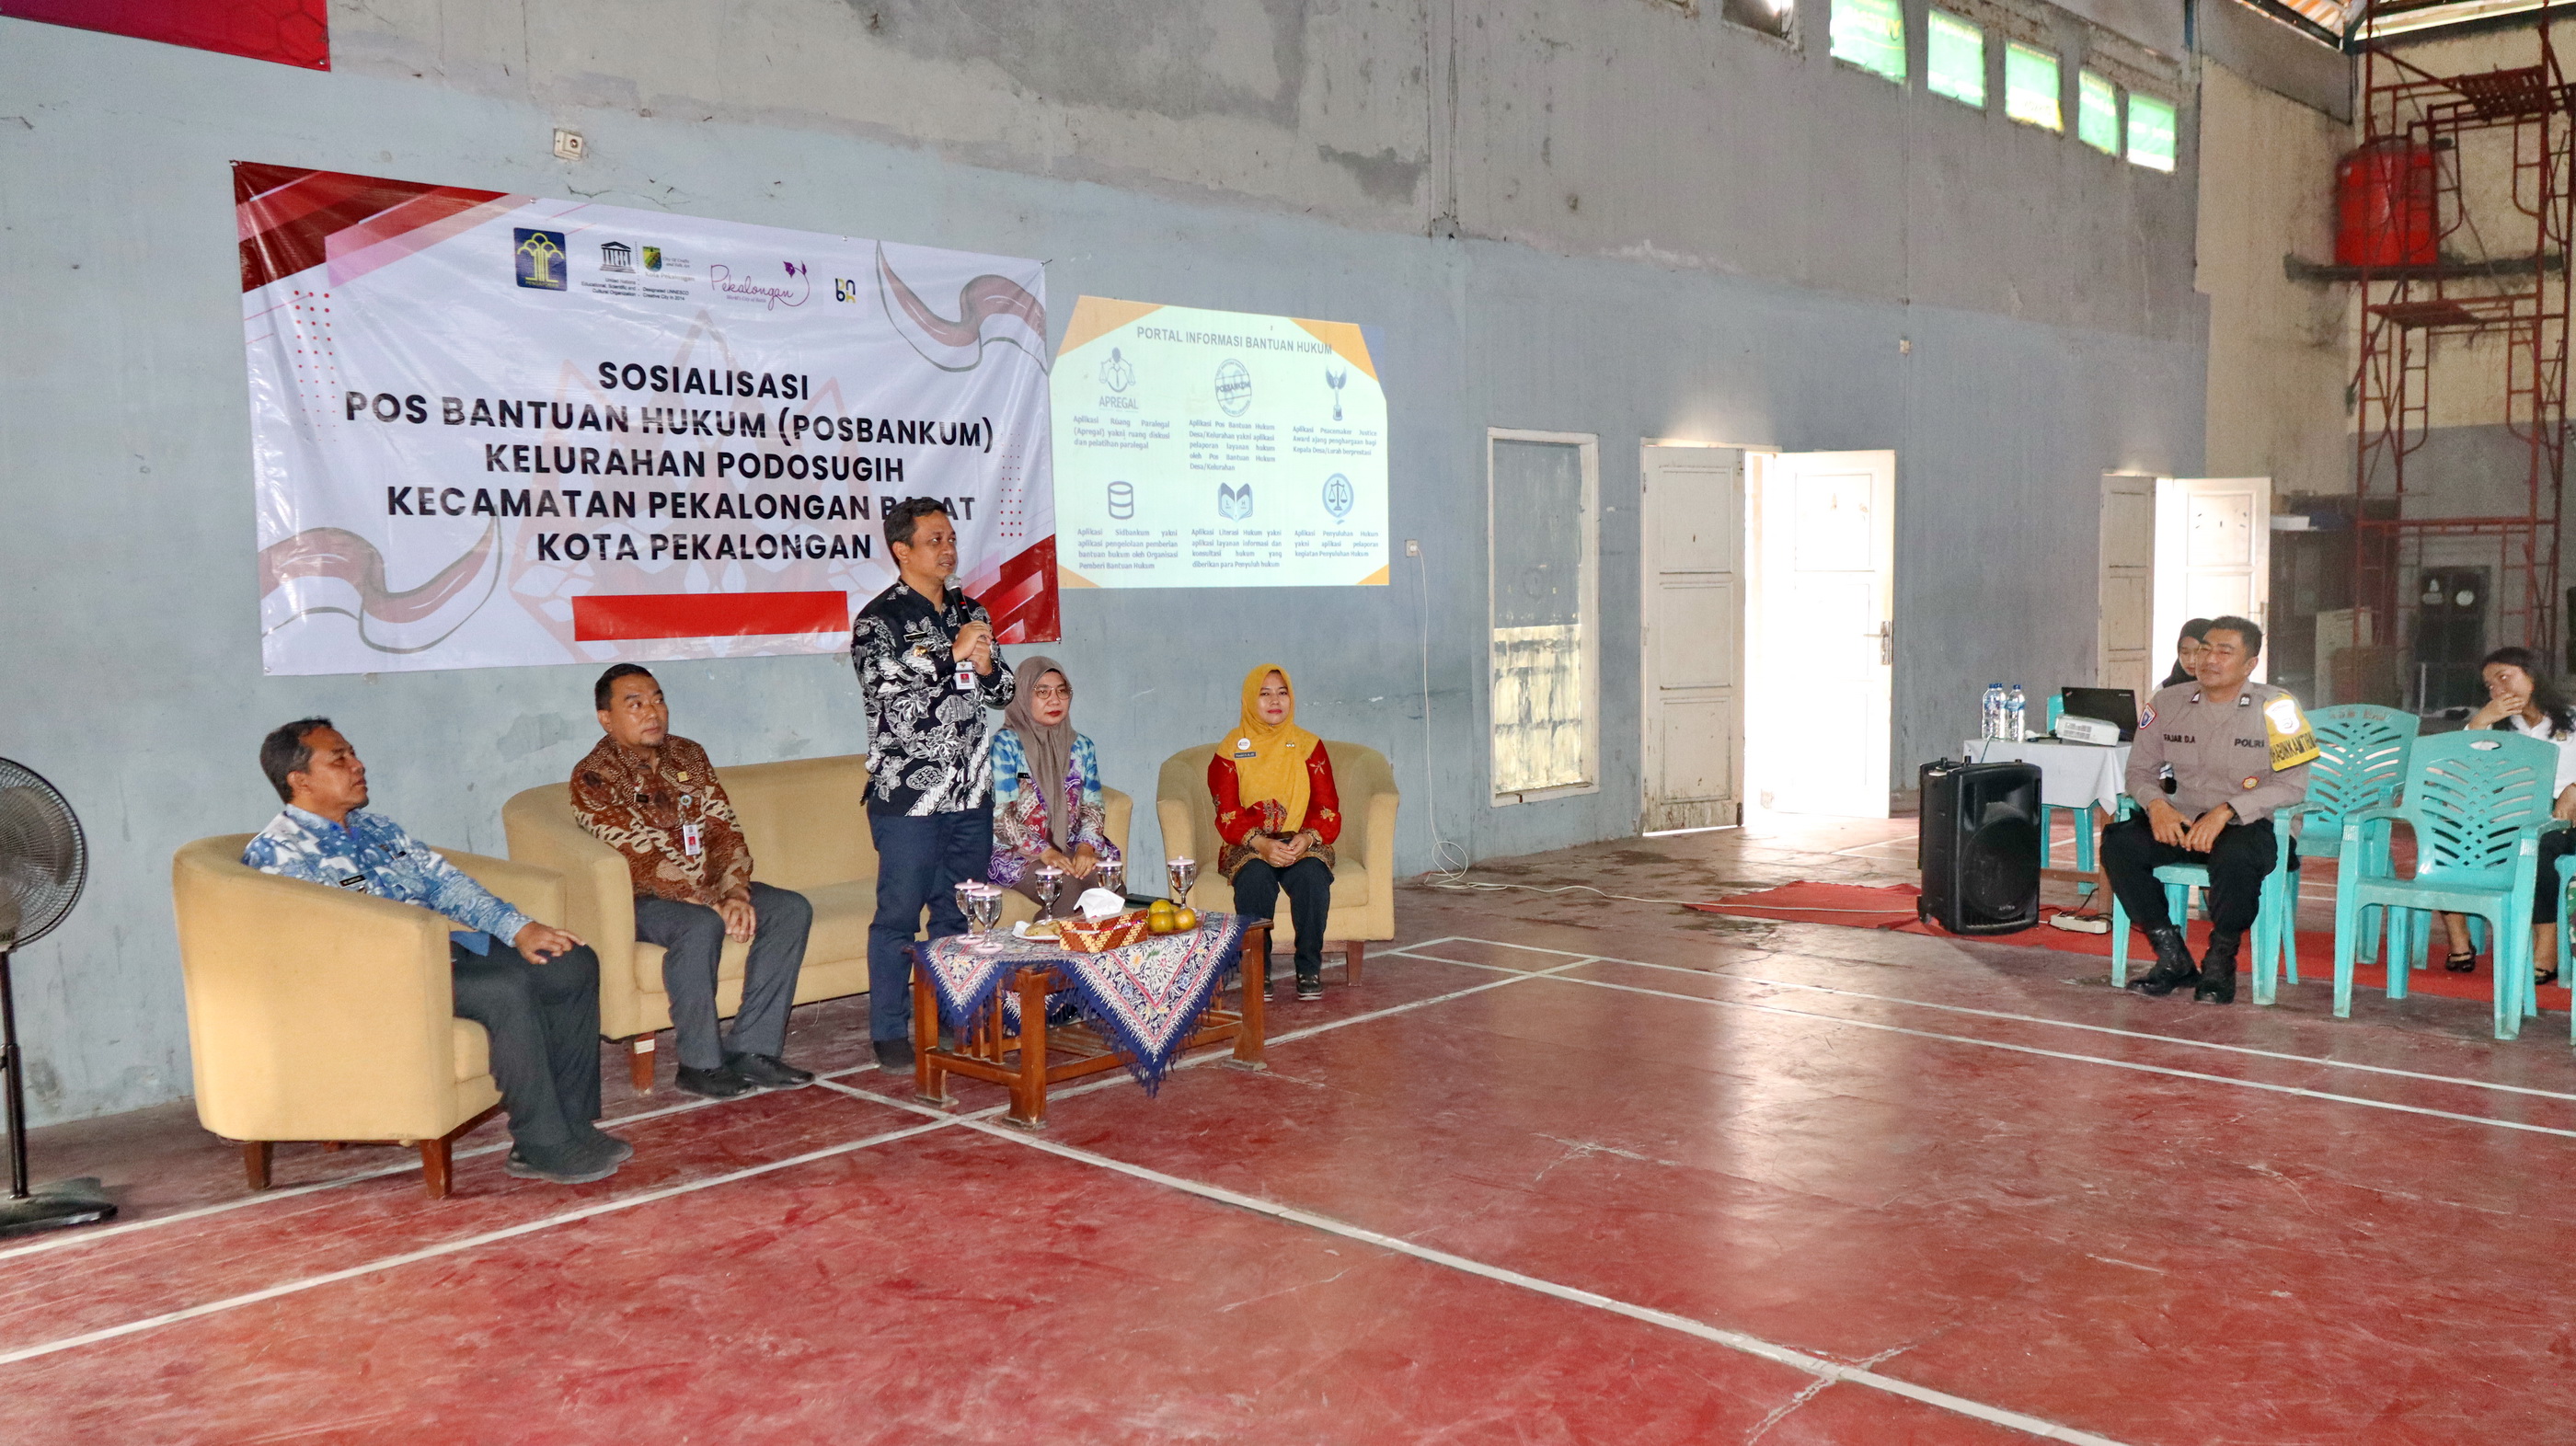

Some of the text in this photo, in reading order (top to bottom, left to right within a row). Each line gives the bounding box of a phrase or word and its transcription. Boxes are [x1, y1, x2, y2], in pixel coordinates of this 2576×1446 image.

[710, 264, 794, 311] Pekalongan
[1137, 327, 1332, 355] PORTAL INFORMASI BANTUAN HUKUM
[598, 362, 808, 400] SOSIALISASI
[1098, 396, 1139, 409] APREGAL
[345, 391, 993, 453] POS BANTUAN HUKUM (POSBANKUM)
[1074, 416, 1098, 425] Aplikasi
[1142, 420, 1170, 430] Paralegal
[1189, 419, 1212, 429] Aplikasi
[1074, 427, 1170, 440] (Apregal) yakni ruang diskusi
[1189, 430, 1235, 440] Desa/Kelurahan
[1253, 433, 1275, 442] aplikasi
[1320, 427, 1352, 435] Peacemaker
[1088, 440, 1119, 448] pelatihan
[1120, 442, 1149, 450] paralegal
[1190, 442, 1219, 450] pelaporan
[486, 443, 903, 482] KELURAHAN PODOSUGIH
[1190, 463, 1236, 471] Desa/Kelurahan
[387, 486, 975, 520] KECAMATAN PEKALONGAN BAT
[1077, 528, 1103, 536] Aplikasi
[1161, 529, 1178, 537] yakni
[537, 534, 870, 561] KOTA PEKALONGAN
[1077, 540, 1103, 548] aplikasi
[1105, 540, 1144, 548] pengelolaan
[1191, 540, 1214, 548] aplikasi
[1216, 540, 1239, 548] layanan
[1146, 551, 1179, 559] Organisasi
[2163, 733, 2182, 743] FAJAR
[2234, 738, 2264, 748] POLRI
